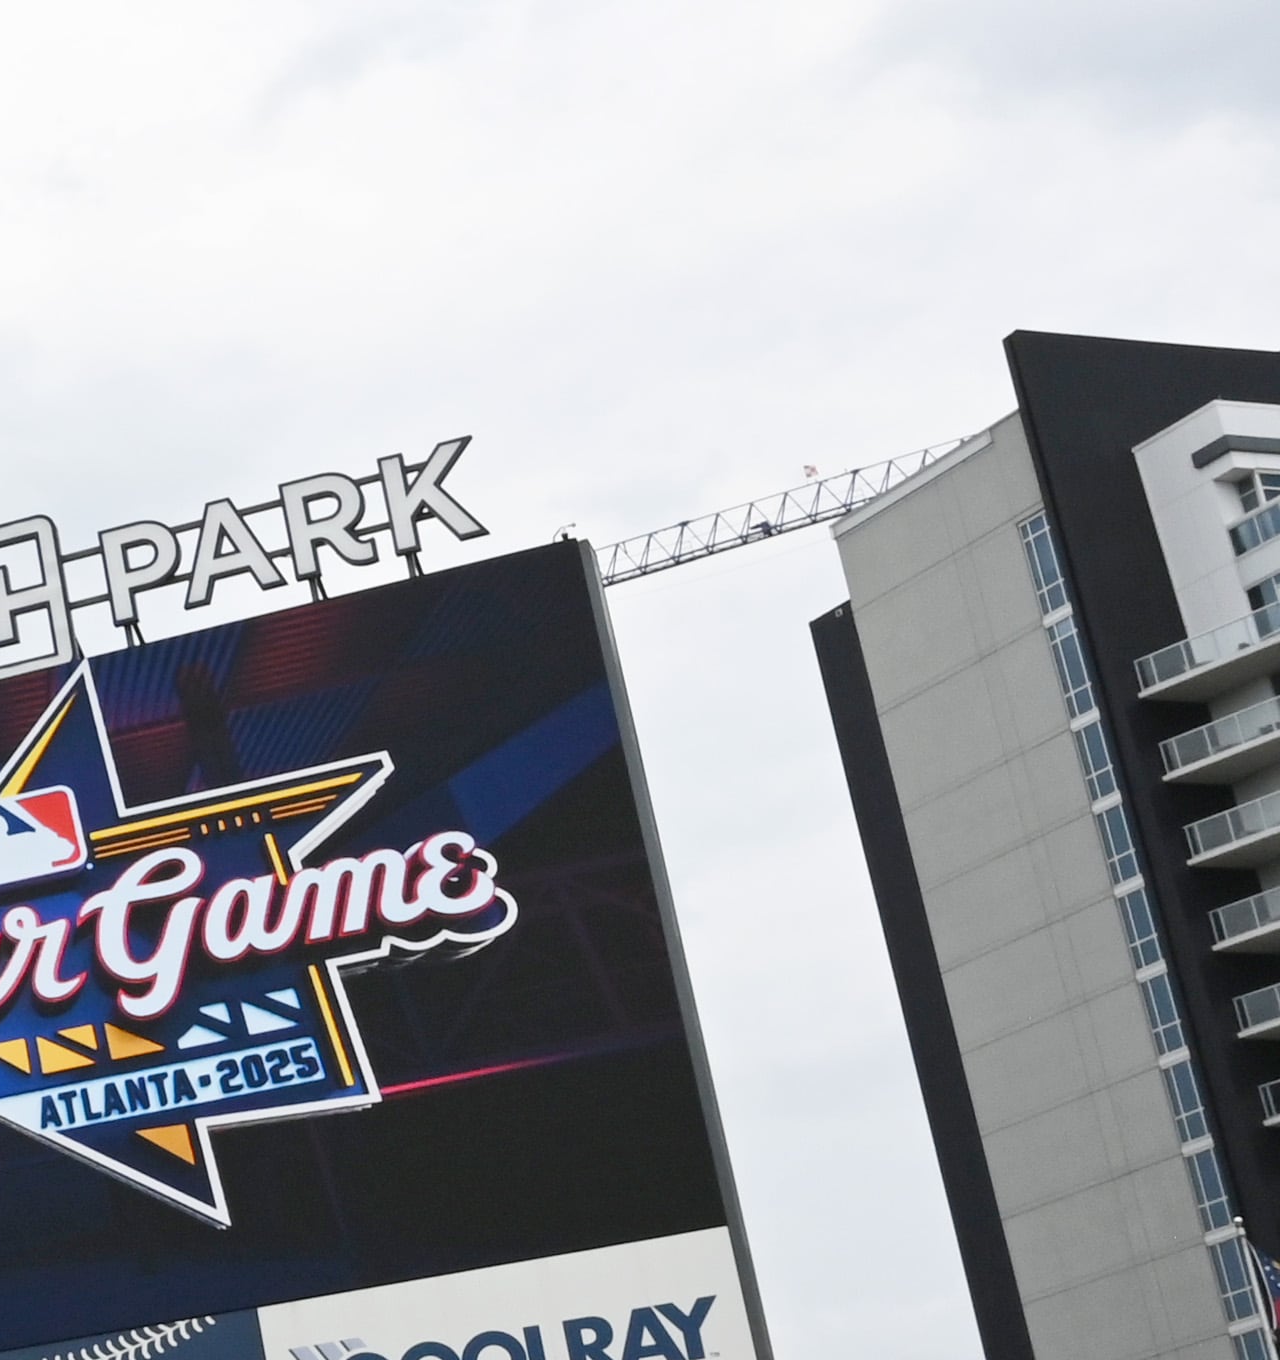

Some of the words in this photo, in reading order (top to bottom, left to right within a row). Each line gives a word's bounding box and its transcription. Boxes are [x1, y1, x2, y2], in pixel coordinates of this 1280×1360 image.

[99, 434, 490, 624] PARK
[80, 830, 500, 1020] Game
[39, 1068, 197, 1130] ATLANTA
[215, 1041, 321, 1096] 2025
